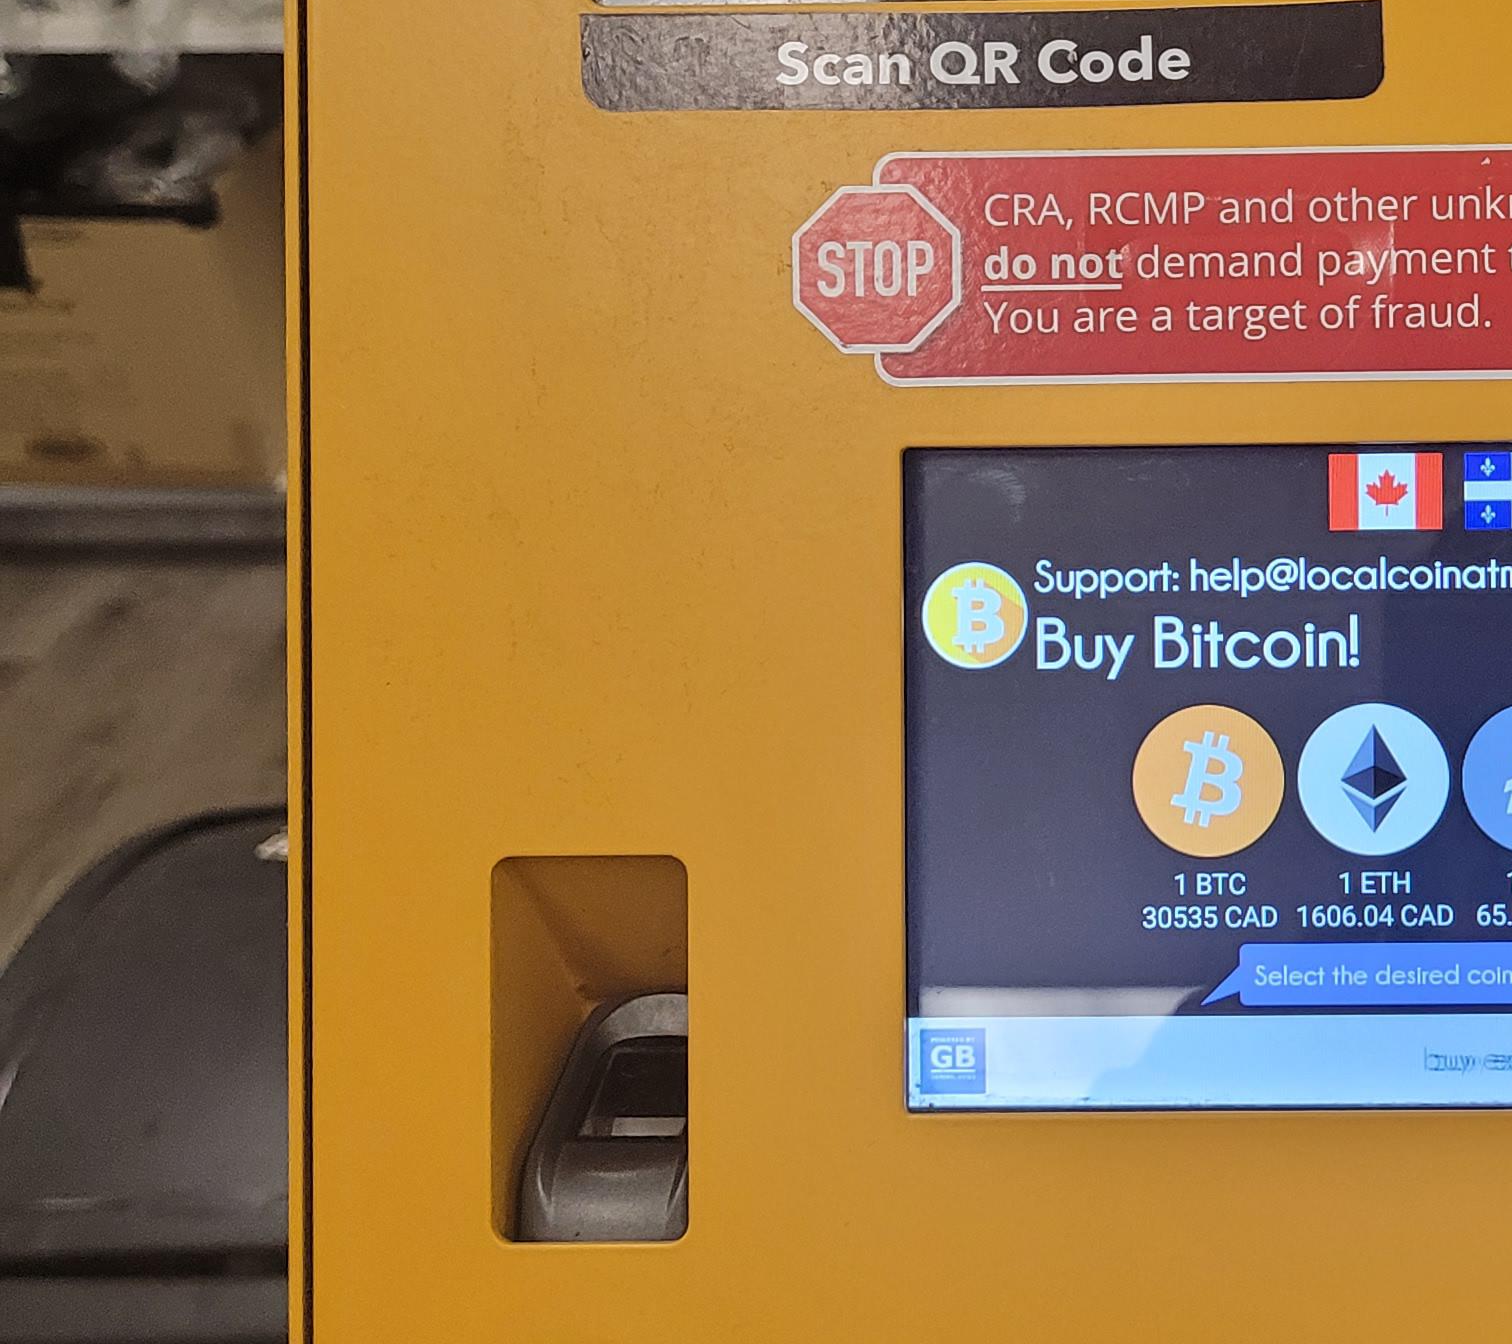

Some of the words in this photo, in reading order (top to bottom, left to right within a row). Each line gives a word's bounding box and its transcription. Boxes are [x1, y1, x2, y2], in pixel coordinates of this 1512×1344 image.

[772, 36, 916, 91] Scan
[928, 41, 1020, 90] QR
[1038, 35, 1190, 83] Code
[981, 194, 1072, 230] CRA,
[1091, 192, 1204, 224] RCMP
[1218, 189, 1292, 223] and
[1309, 188, 1417, 222] other
[817, 241, 934, 297] STOP
[984, 246, 1037, 282] do
[1050, 246, 1124, 282] not
[1138, 243, 1301, 278] demand
[1319, 237, 1496, 285] payment
[984, 302, 1058, 333] You
[1074, 308, 1137, 332] are
[1152, 307, 1171, 331] a
[1186, 301, 1307, 339] target
[1321, 295, 1361, 328] of
[1371, 294, 1490, 328] fraud.
[1034, 560, 1179, 599] Support:
[1037, 617, 1134, 680] Buy
[1155, 615, 1359, 668] Bitcoin!
[1175, 874, 1184, 895] 1
[1197, 873, 1245, 895] BTC
[1339, 872, 1349, 893] 1
[1361, 872, 1410, 893] ETH
[1143, 906, 1218, 928] 30535
[1225, 906, 1277, 928] CAD
[1297, 905, 1394, 927] 1606.04
[1401, 904, 1453, 926] CAD
[1254, 965, 1325, 986] Select
[1332, 965, 1368, 985] the
[1375, 964, 1459, 985] desired
[930, 1044, 976, 1069] GB
